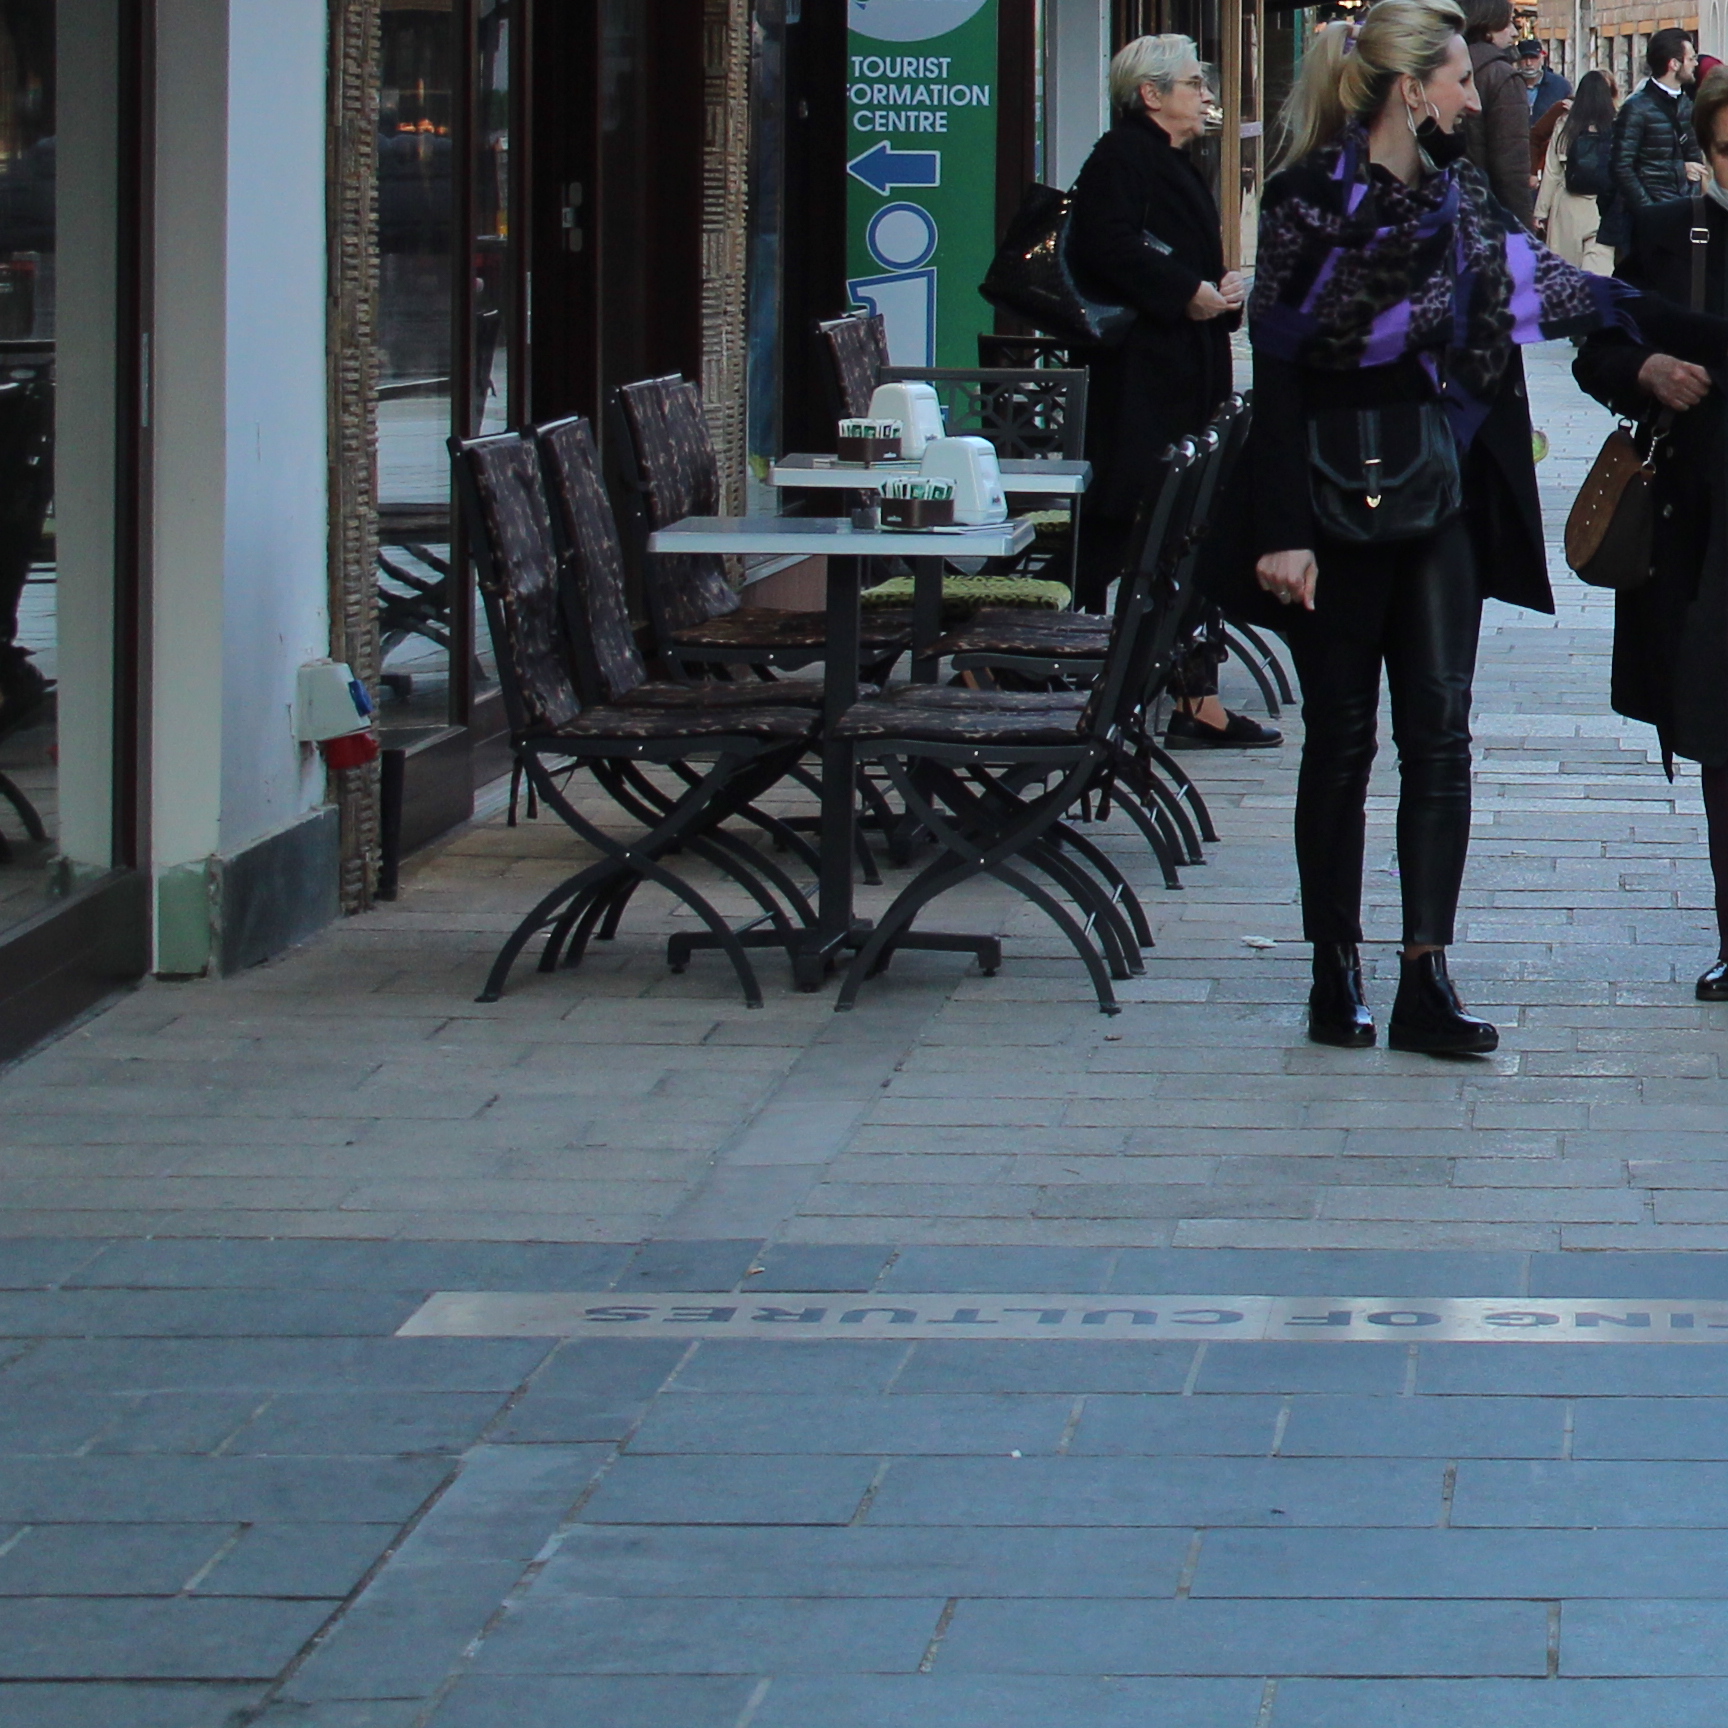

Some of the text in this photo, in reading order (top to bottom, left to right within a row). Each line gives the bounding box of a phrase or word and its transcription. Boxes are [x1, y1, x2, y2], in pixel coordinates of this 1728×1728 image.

[851, 56, 951, 78] TOURIST
[847, 83, 990, 106] ORMATION
[853, 110, 948, 132] CENTRE
[582, 1305, 1245, 1326] CULTURES
[1284, 1309, 1442, 1327] OF
